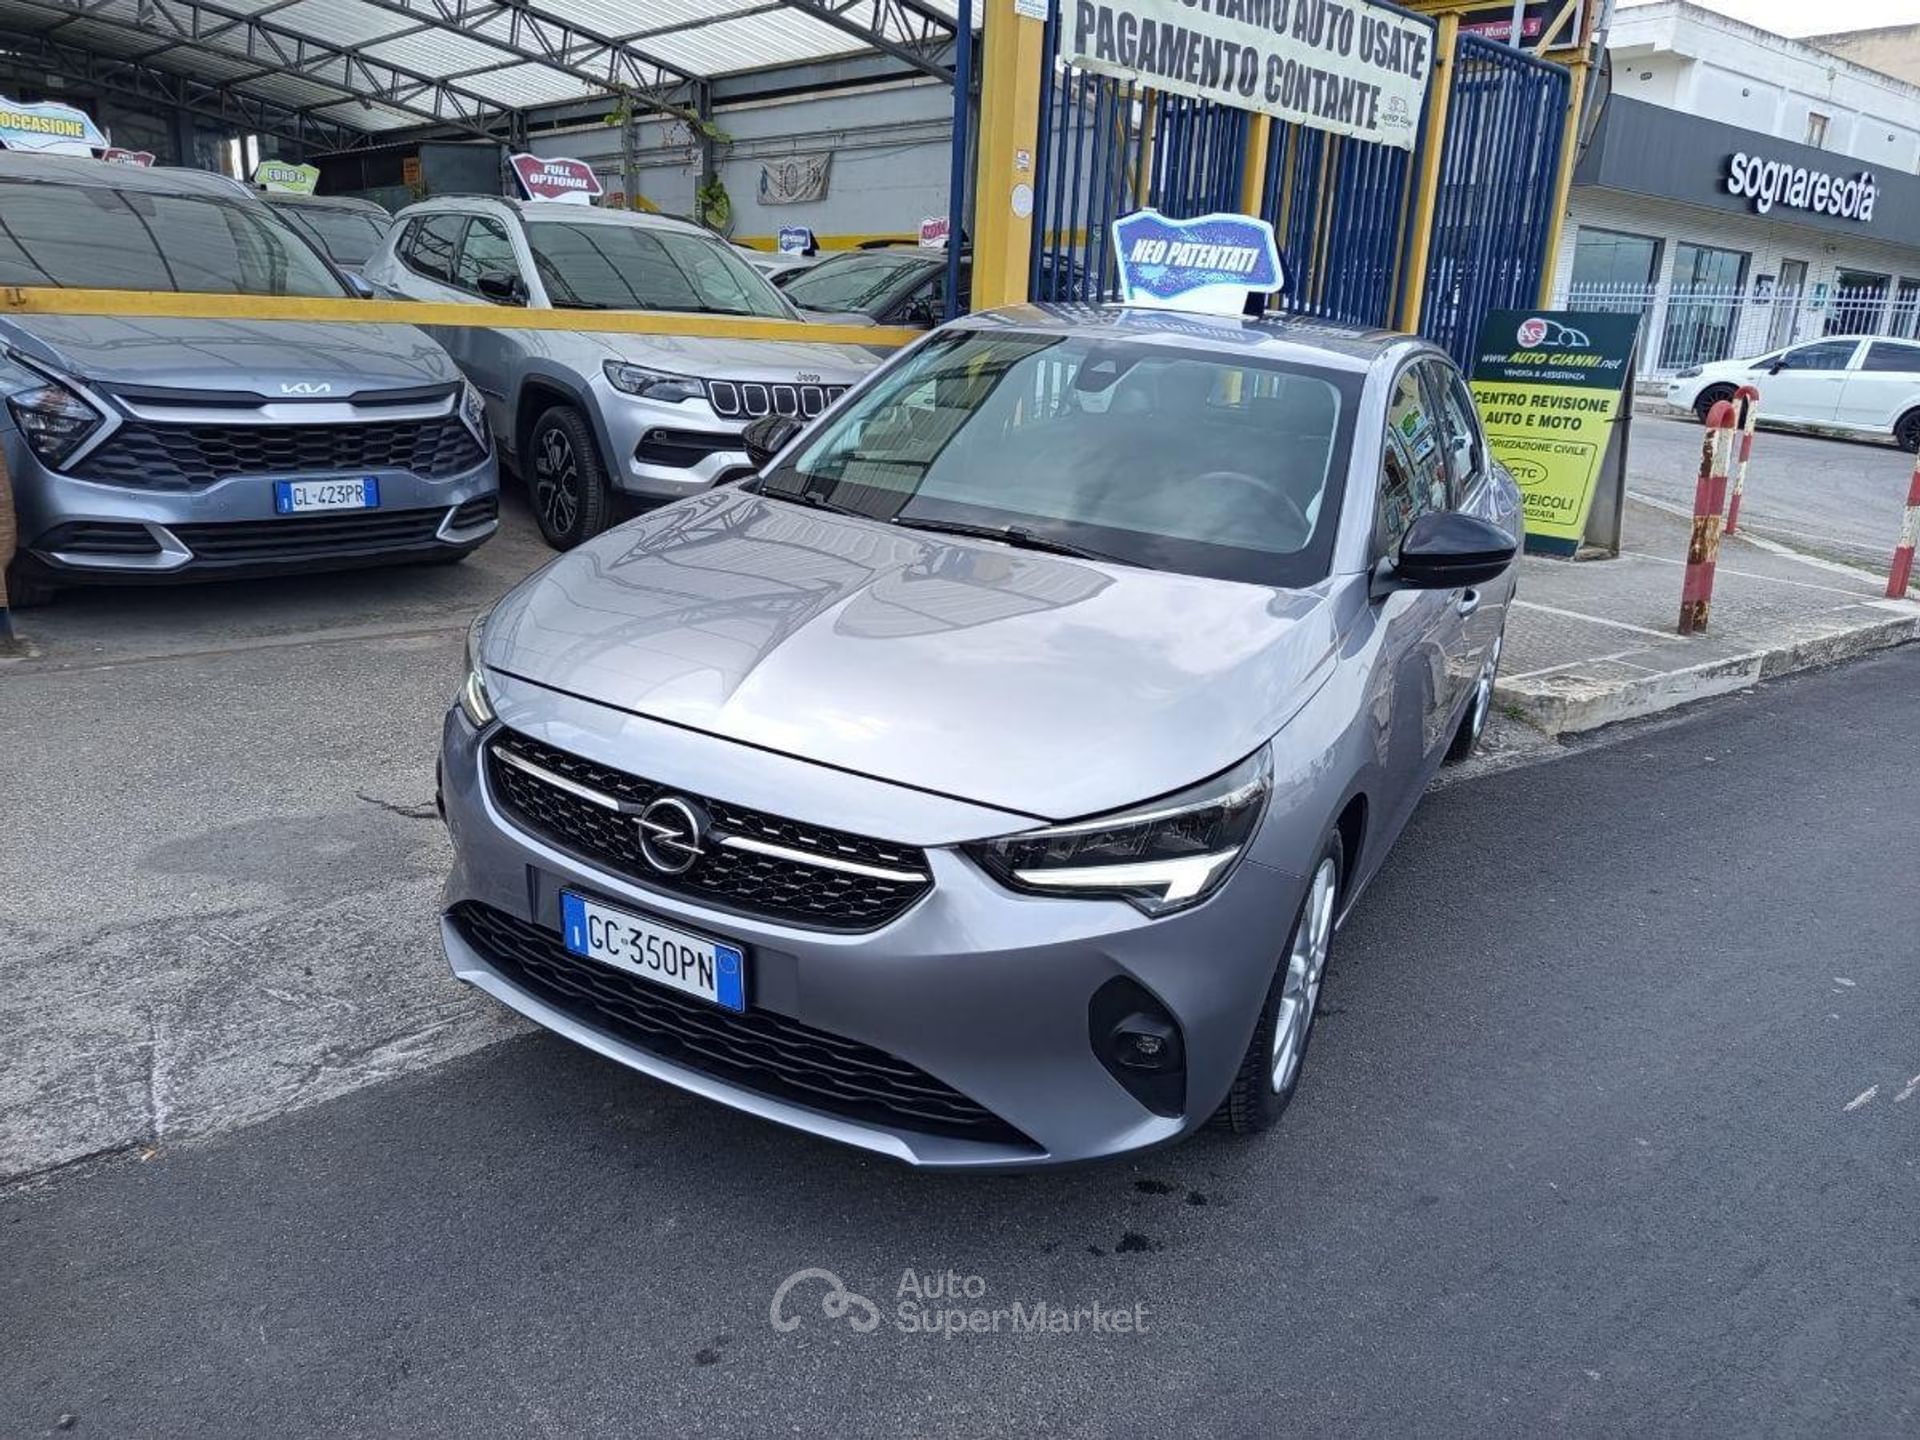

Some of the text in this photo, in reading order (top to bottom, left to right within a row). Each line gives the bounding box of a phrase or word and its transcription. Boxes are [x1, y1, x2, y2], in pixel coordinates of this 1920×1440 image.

[1292, 0, 1354, 56] AUTO
[1360, 15, 1428, 80] USATE
[1075, 1, 1259, 97] PAGAMENTO
[1265, 54, 1382, 130] CONTANTE
[0, 112, 84, 138] OCCASIONE
[544, 164, 571, 176] FULL
[529, 173, 588, 189] OPTIONAL
[1130, 238, 1260, 272] NEO PATENTATI
[1474, 391, 1610, 412] CENTRO REVISIONE
[1485, 412, 1582, 430] AUTO E MOTO
[1486, 438, 1588, 455] ORIZZAZIONE CIVILE
[1510, 467, 1537, 478] CTC
